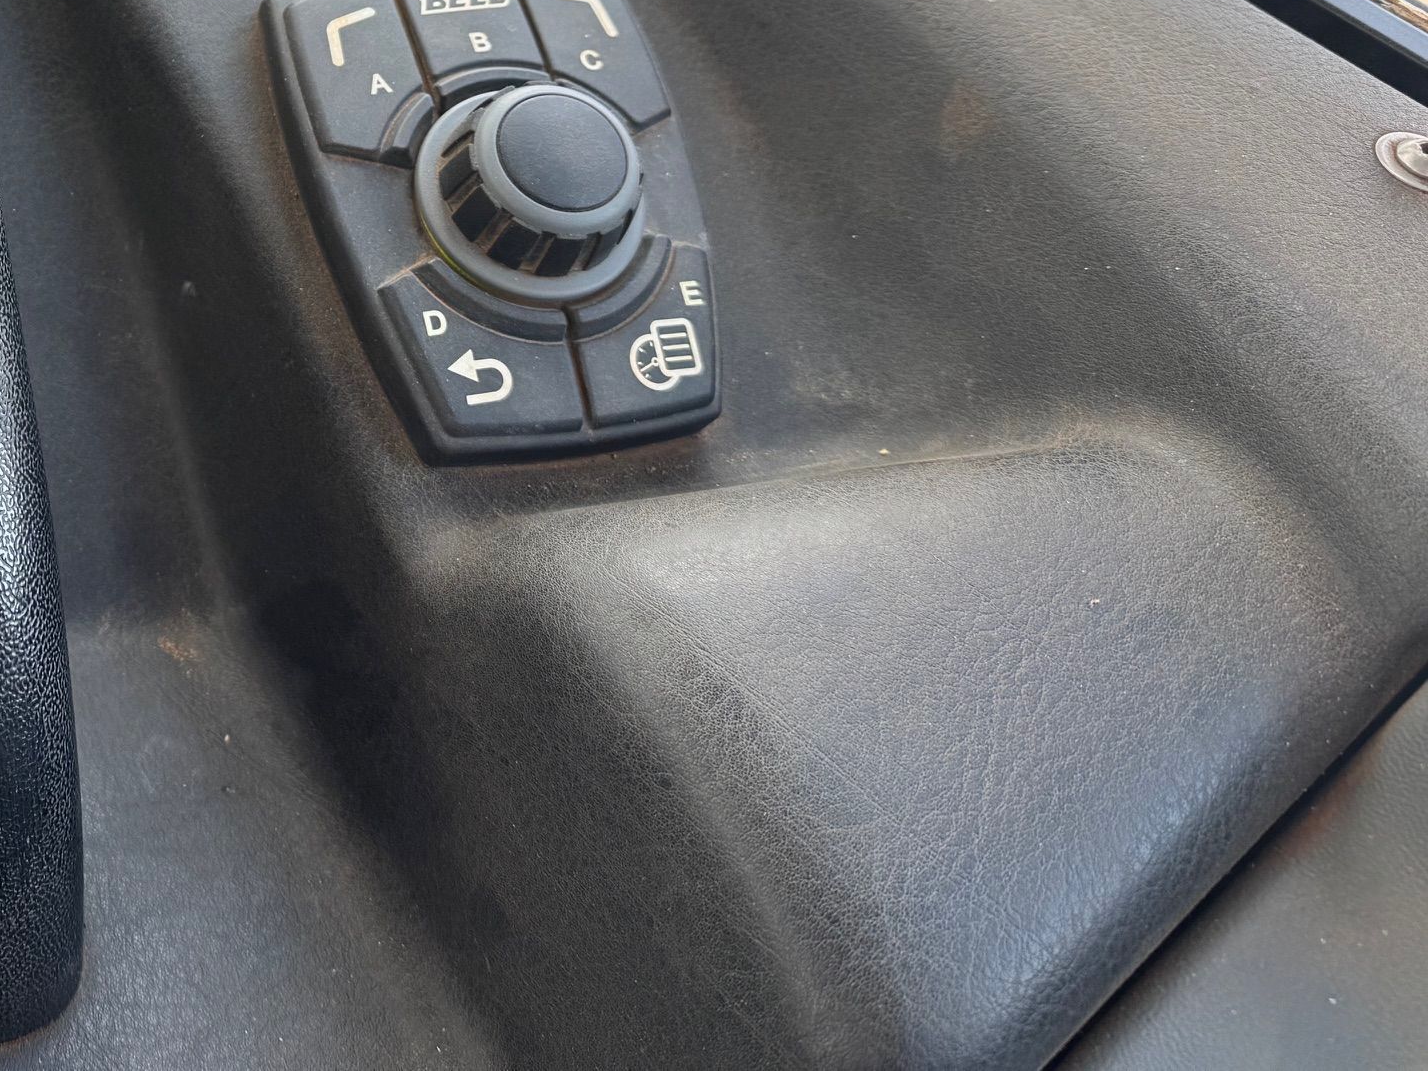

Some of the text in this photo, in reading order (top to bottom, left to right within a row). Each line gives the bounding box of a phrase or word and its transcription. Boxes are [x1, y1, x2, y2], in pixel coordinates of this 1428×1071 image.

[469, 32, 492, 53] B
[579, 50, 604, 71] C
[370, 73, 393, 95] A
[680, 281, 706, 306] E
[422, 310, 448, 337] D
